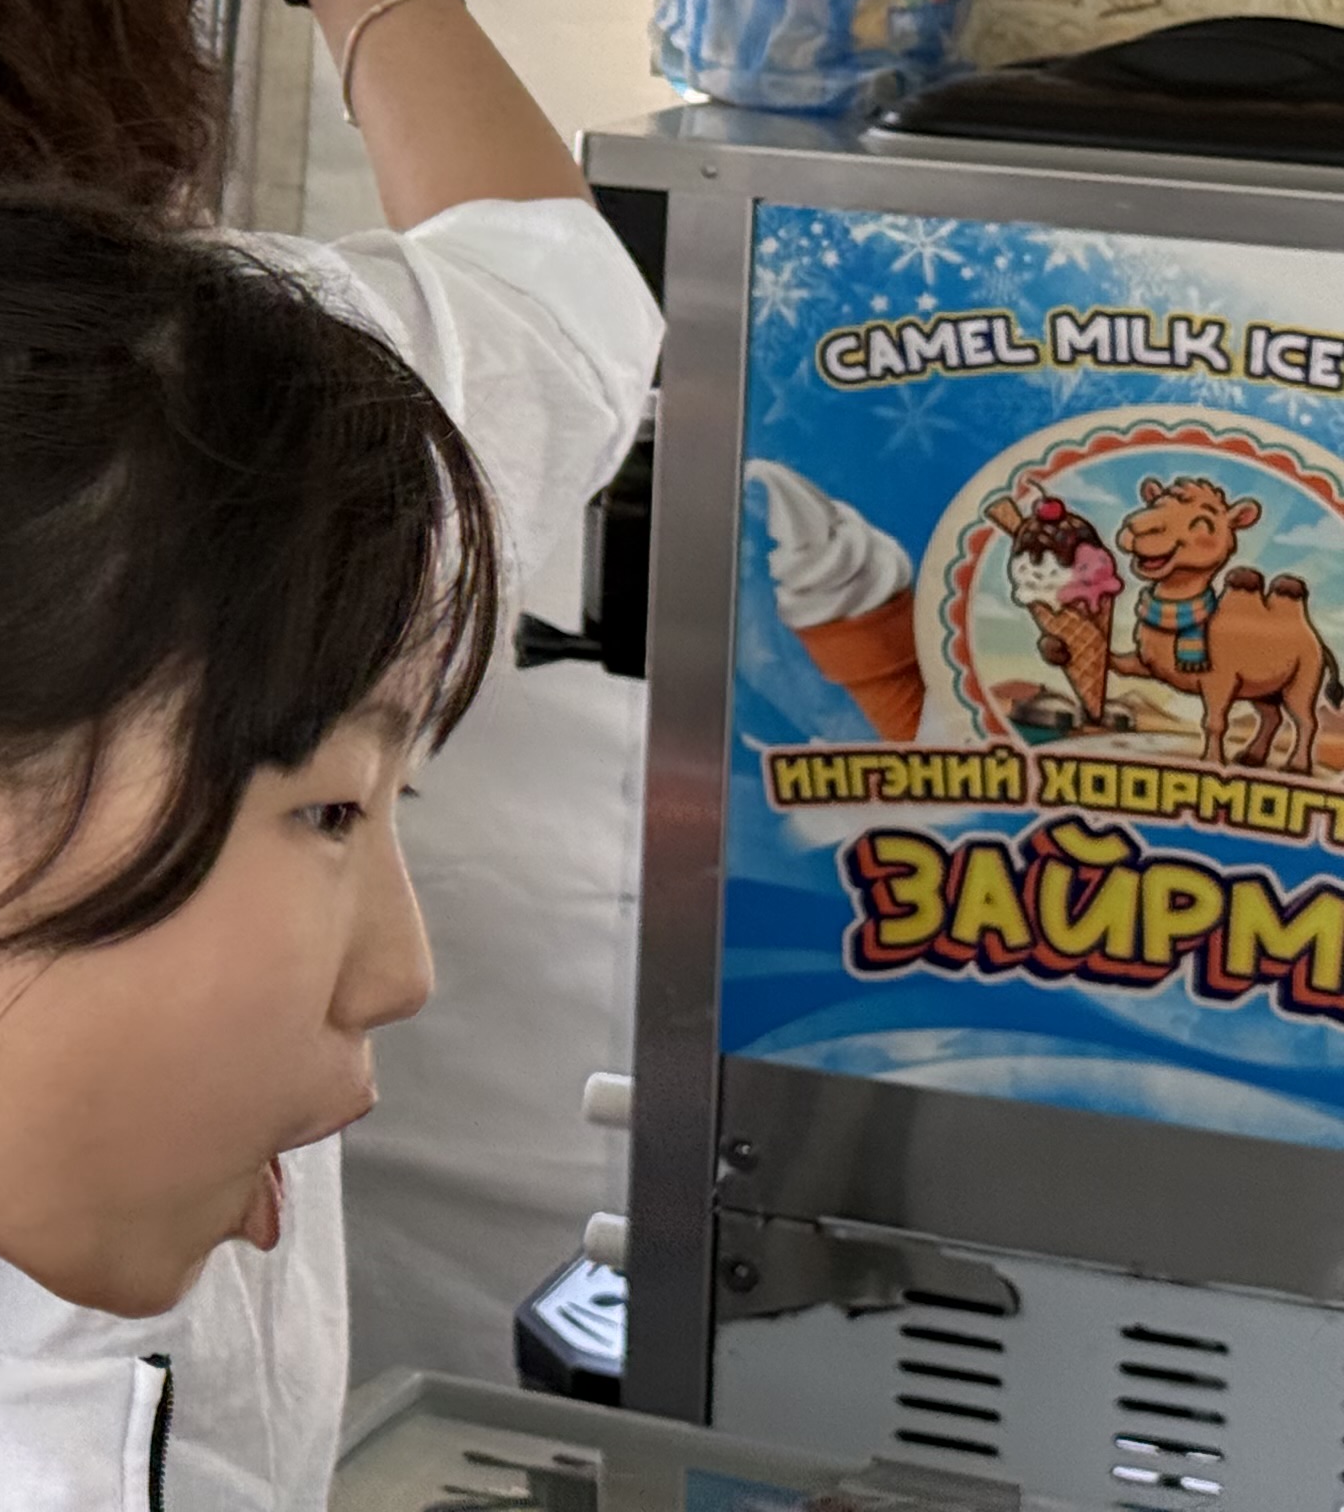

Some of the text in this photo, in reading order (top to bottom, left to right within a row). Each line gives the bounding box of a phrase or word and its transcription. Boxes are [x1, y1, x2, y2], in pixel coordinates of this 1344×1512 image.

[823, 313, 1344, 389] CAMEL MILK ICE
[773, 750, 1023, 803] ИНГЭНИЙ
